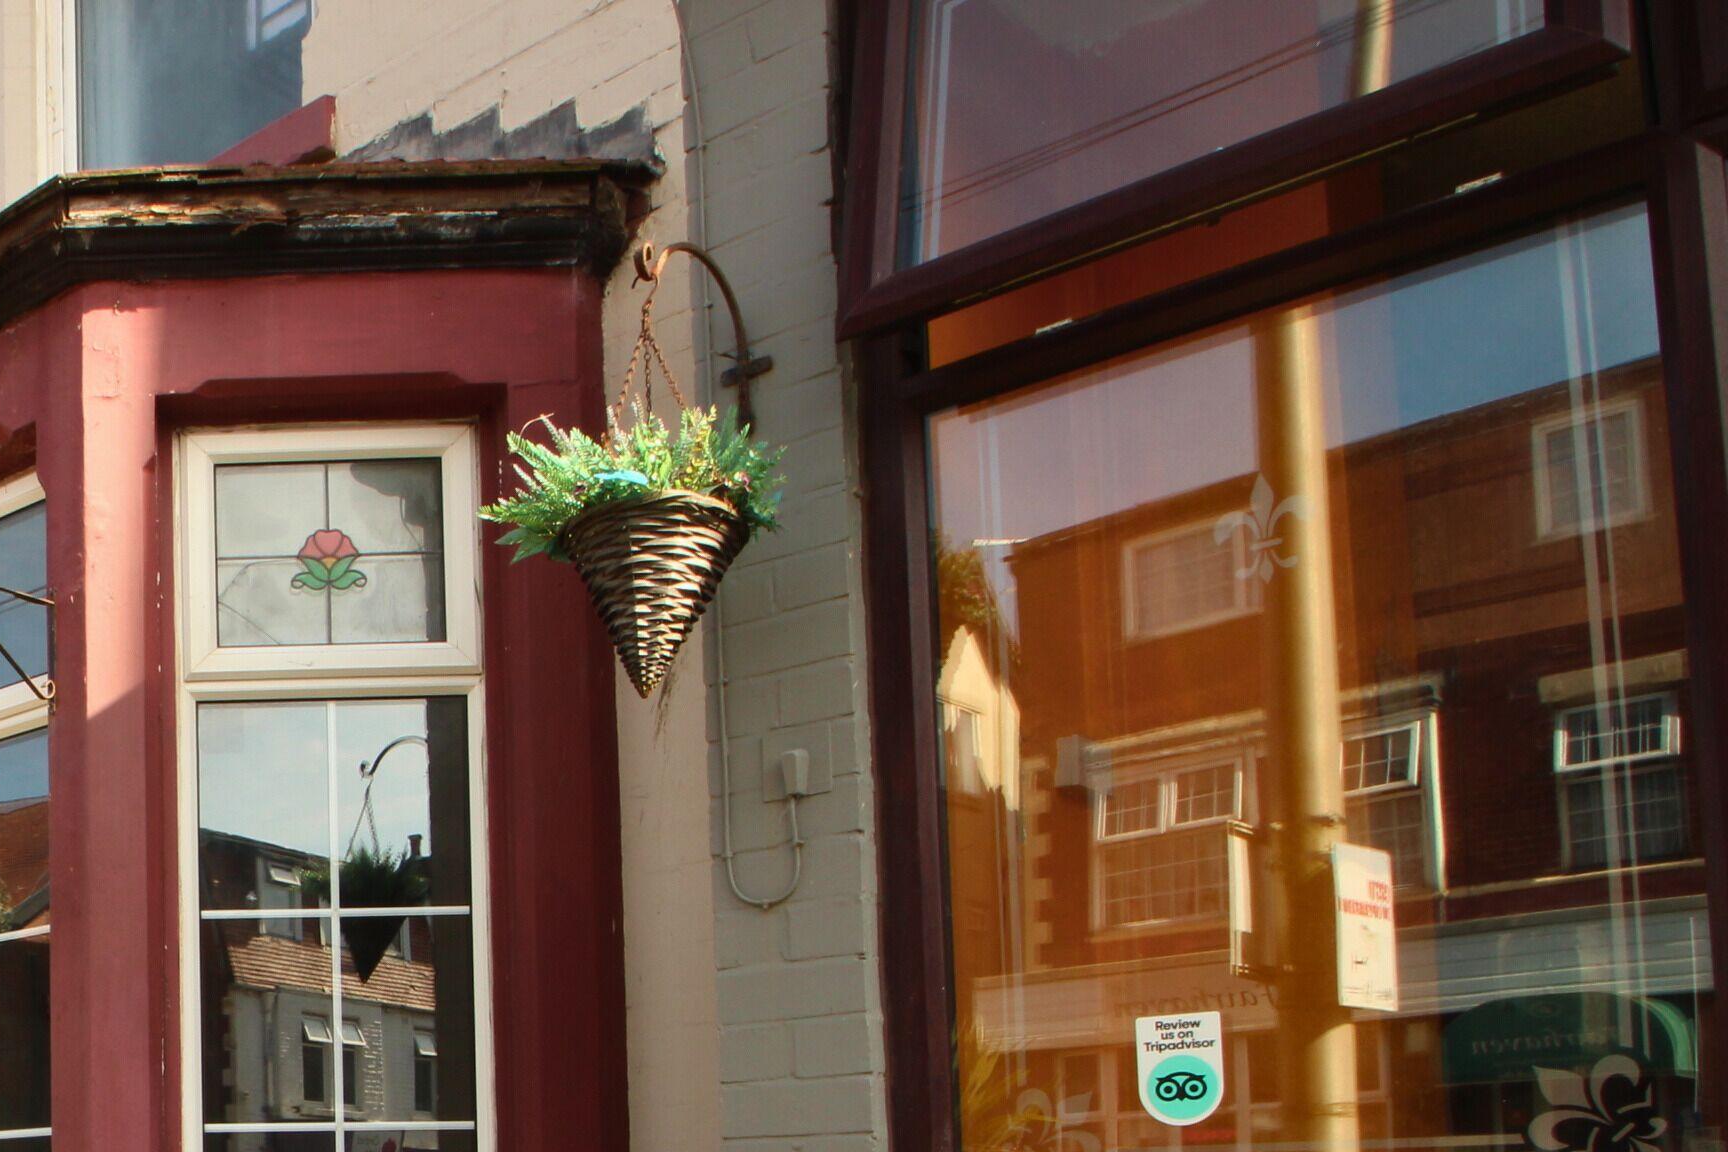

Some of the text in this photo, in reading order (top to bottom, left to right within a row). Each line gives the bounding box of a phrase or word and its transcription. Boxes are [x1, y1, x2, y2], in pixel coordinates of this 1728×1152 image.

[1155, 1019, 1201, 1031] Review
[1161, 1030, 1194, 1040] us on
[1143, 1038, 1216, 1053] Tripadvisor
